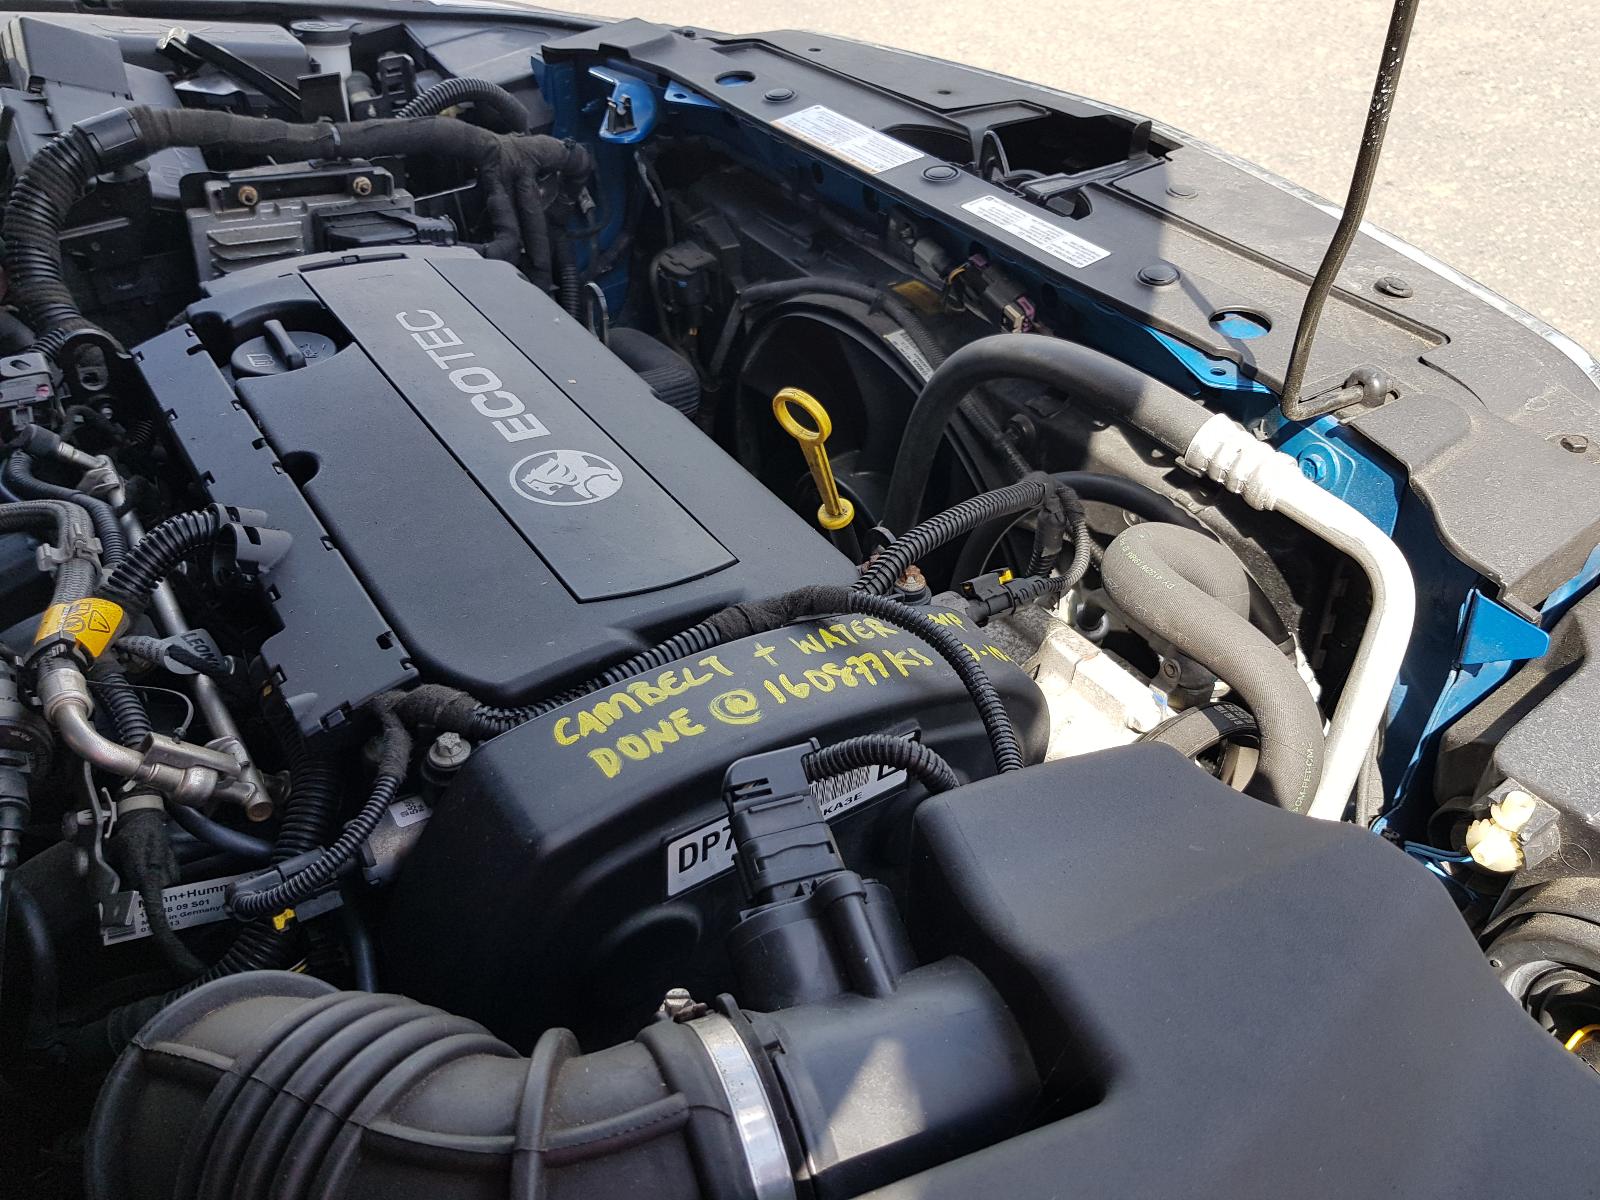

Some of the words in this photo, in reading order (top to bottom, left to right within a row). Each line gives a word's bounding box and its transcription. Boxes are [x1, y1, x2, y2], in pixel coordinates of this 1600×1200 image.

[395, 309, 551, 443] ECOTEC
[180, 633, 220, 668] LEON
[553, 656, 735, 747] CAMBELT
[788, 615, 896, 655] WATER
[927, 612, 968, 632] MP
[587, 706, 708, 779] DONE
[710, 689, 763, 726] @
